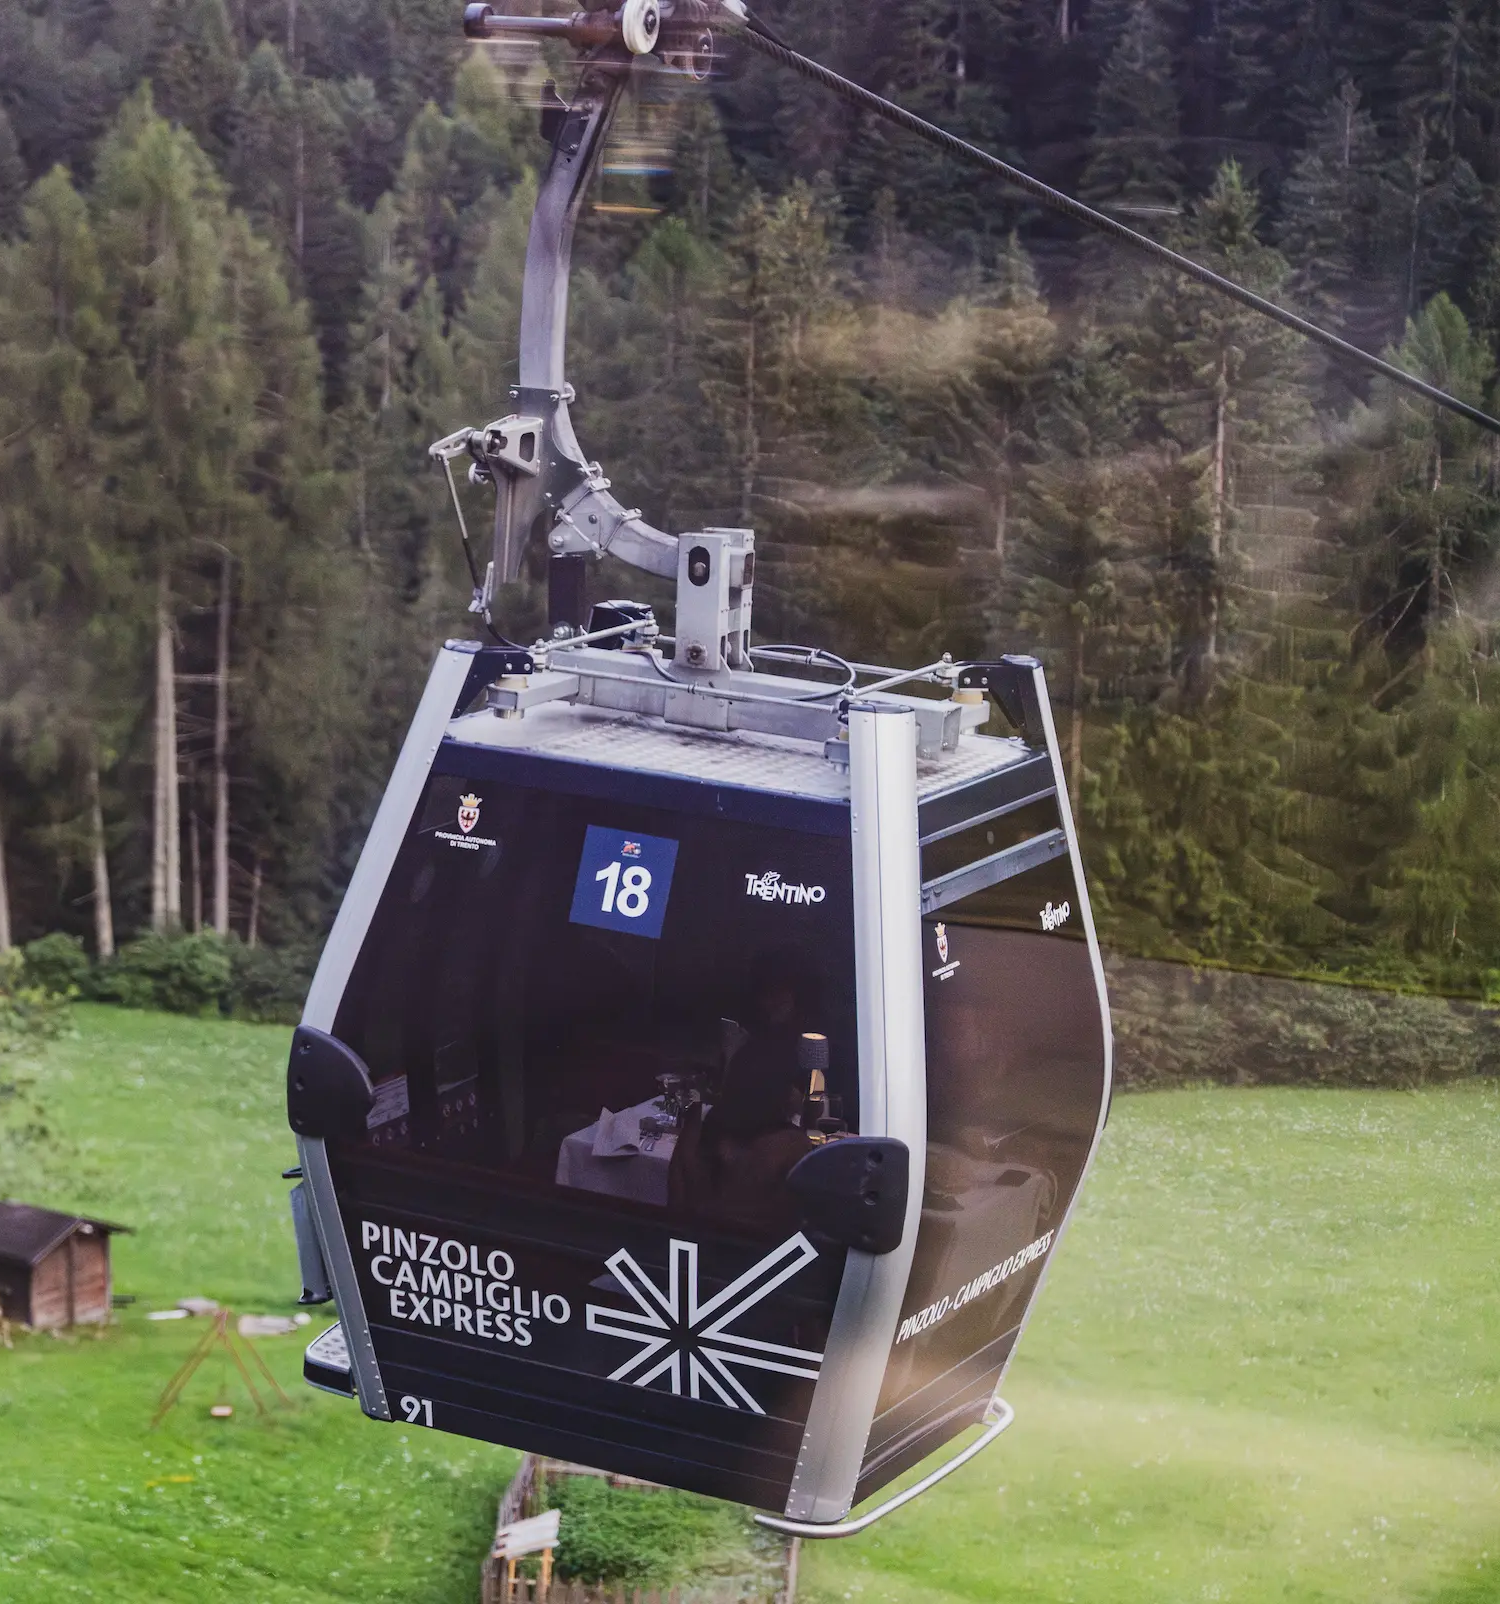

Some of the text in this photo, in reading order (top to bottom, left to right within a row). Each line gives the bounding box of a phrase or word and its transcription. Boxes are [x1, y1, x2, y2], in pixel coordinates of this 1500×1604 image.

[435, 831, 496, 846] PROVINCIA AUTONOMA
[457, 841, 479, 850] TRENTO
[595, 861, 652, 918] 18
[745, 873, 826, 906] TRENTINO
[362, 1220, 515, 1282] PINZOLO
[370, 1254, 571, 1324] CAMPIGLIO
[896, 1295, 950, 1345] PINZOLO
[953, 1255, 1015, 1310] CAMPIGLIO
[1010, 1229, 1055, 1275] EXPRESS
[389, 1288, 533, 1347] EXPRESS
[400, 1395, 434, 1428] 91
